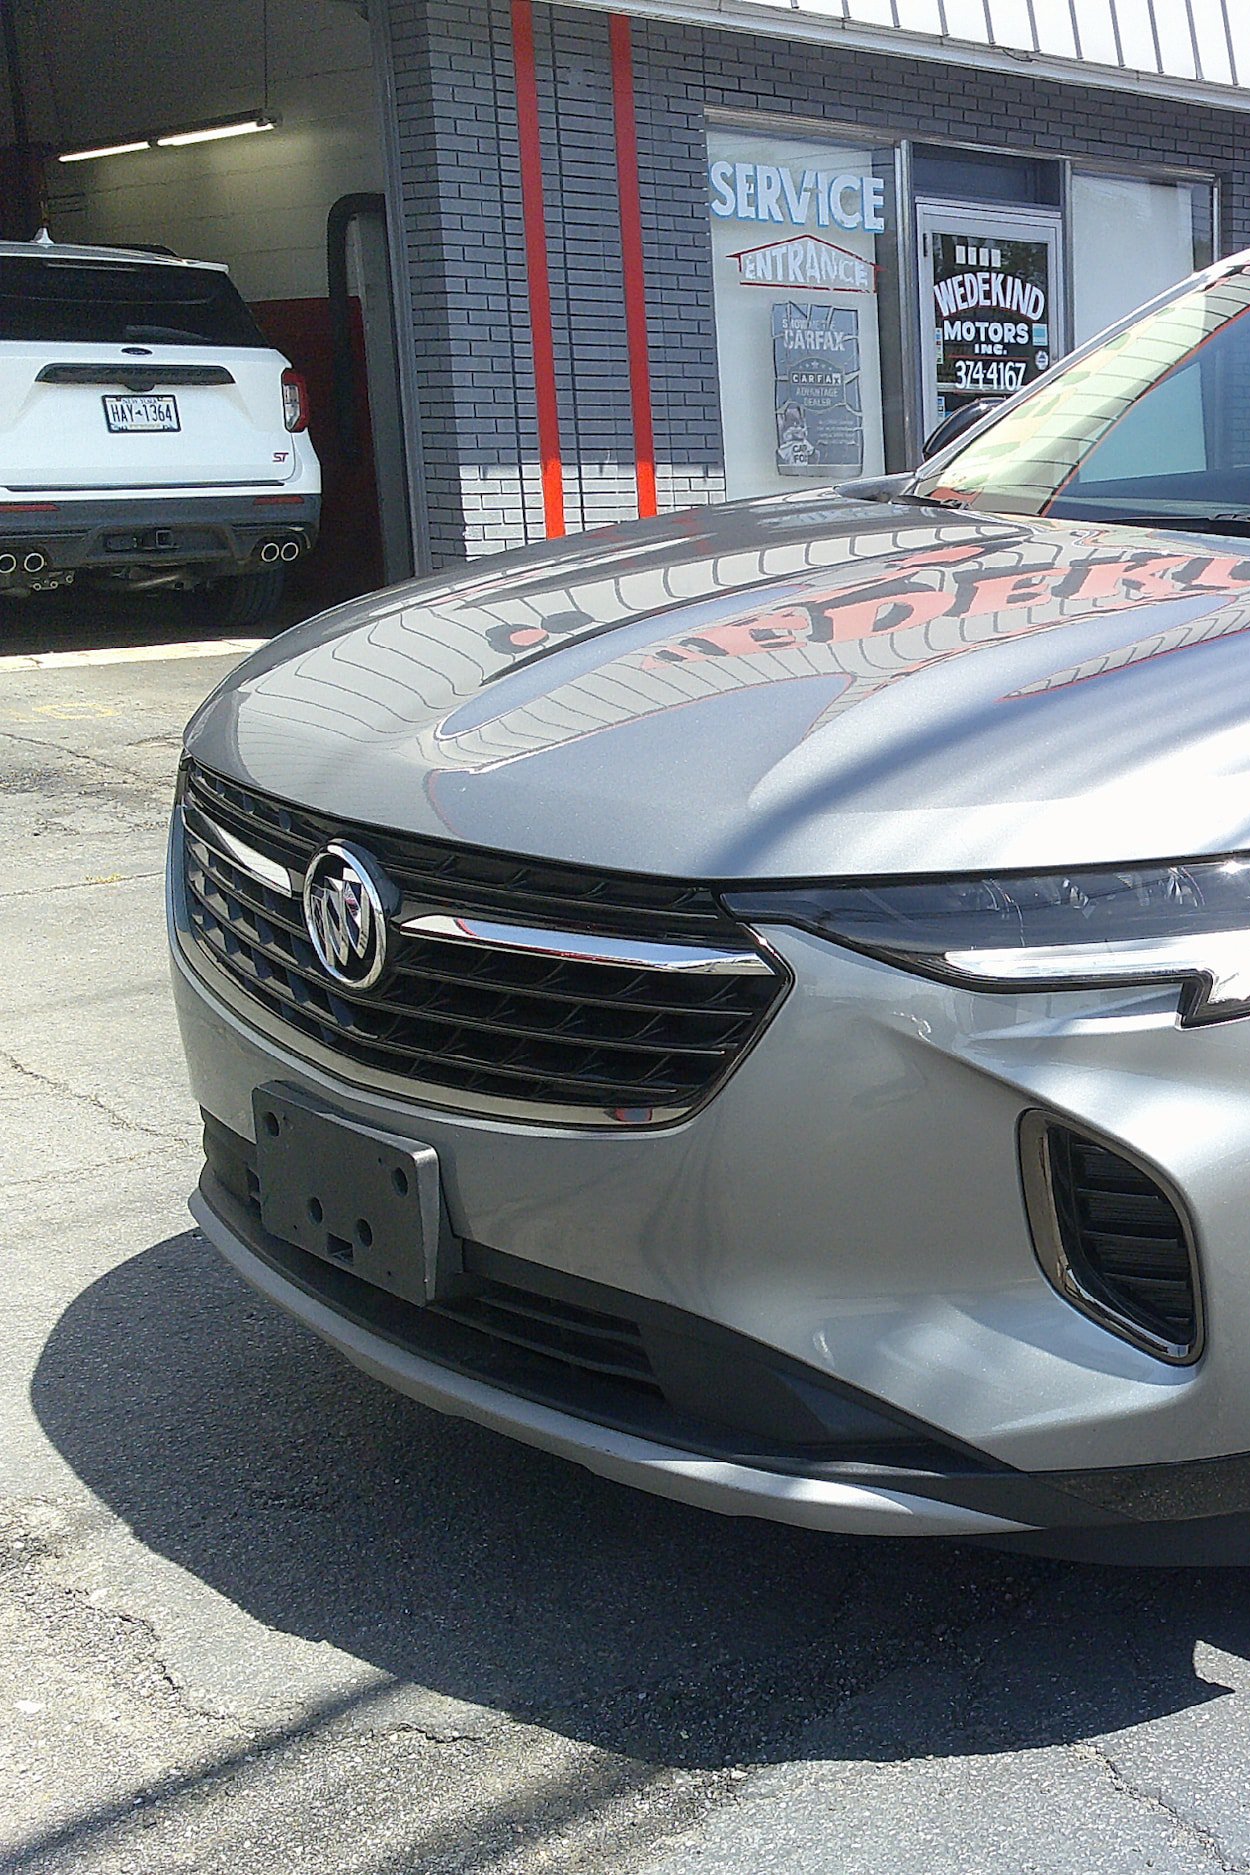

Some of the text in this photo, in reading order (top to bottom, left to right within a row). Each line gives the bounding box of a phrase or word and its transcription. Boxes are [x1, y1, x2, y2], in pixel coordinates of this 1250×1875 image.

[709, 160, 885, 234] SERVICE
[744, 240, 869, 287] ENTRANCE
[933, 271, 1045, 321] WEDEKIND
[783, 329, 846, 352] CARFAX
[943, 320, 1029, 345] MOTORS
[974, 343, 1008, 355] INC.
[791, 372, 841, 385] CARFAX
[954, 360, 1027, 391] 374-4167
[795, 386, 839, 398] ADVANTAGE
[272, 451, 290, 463] ST
